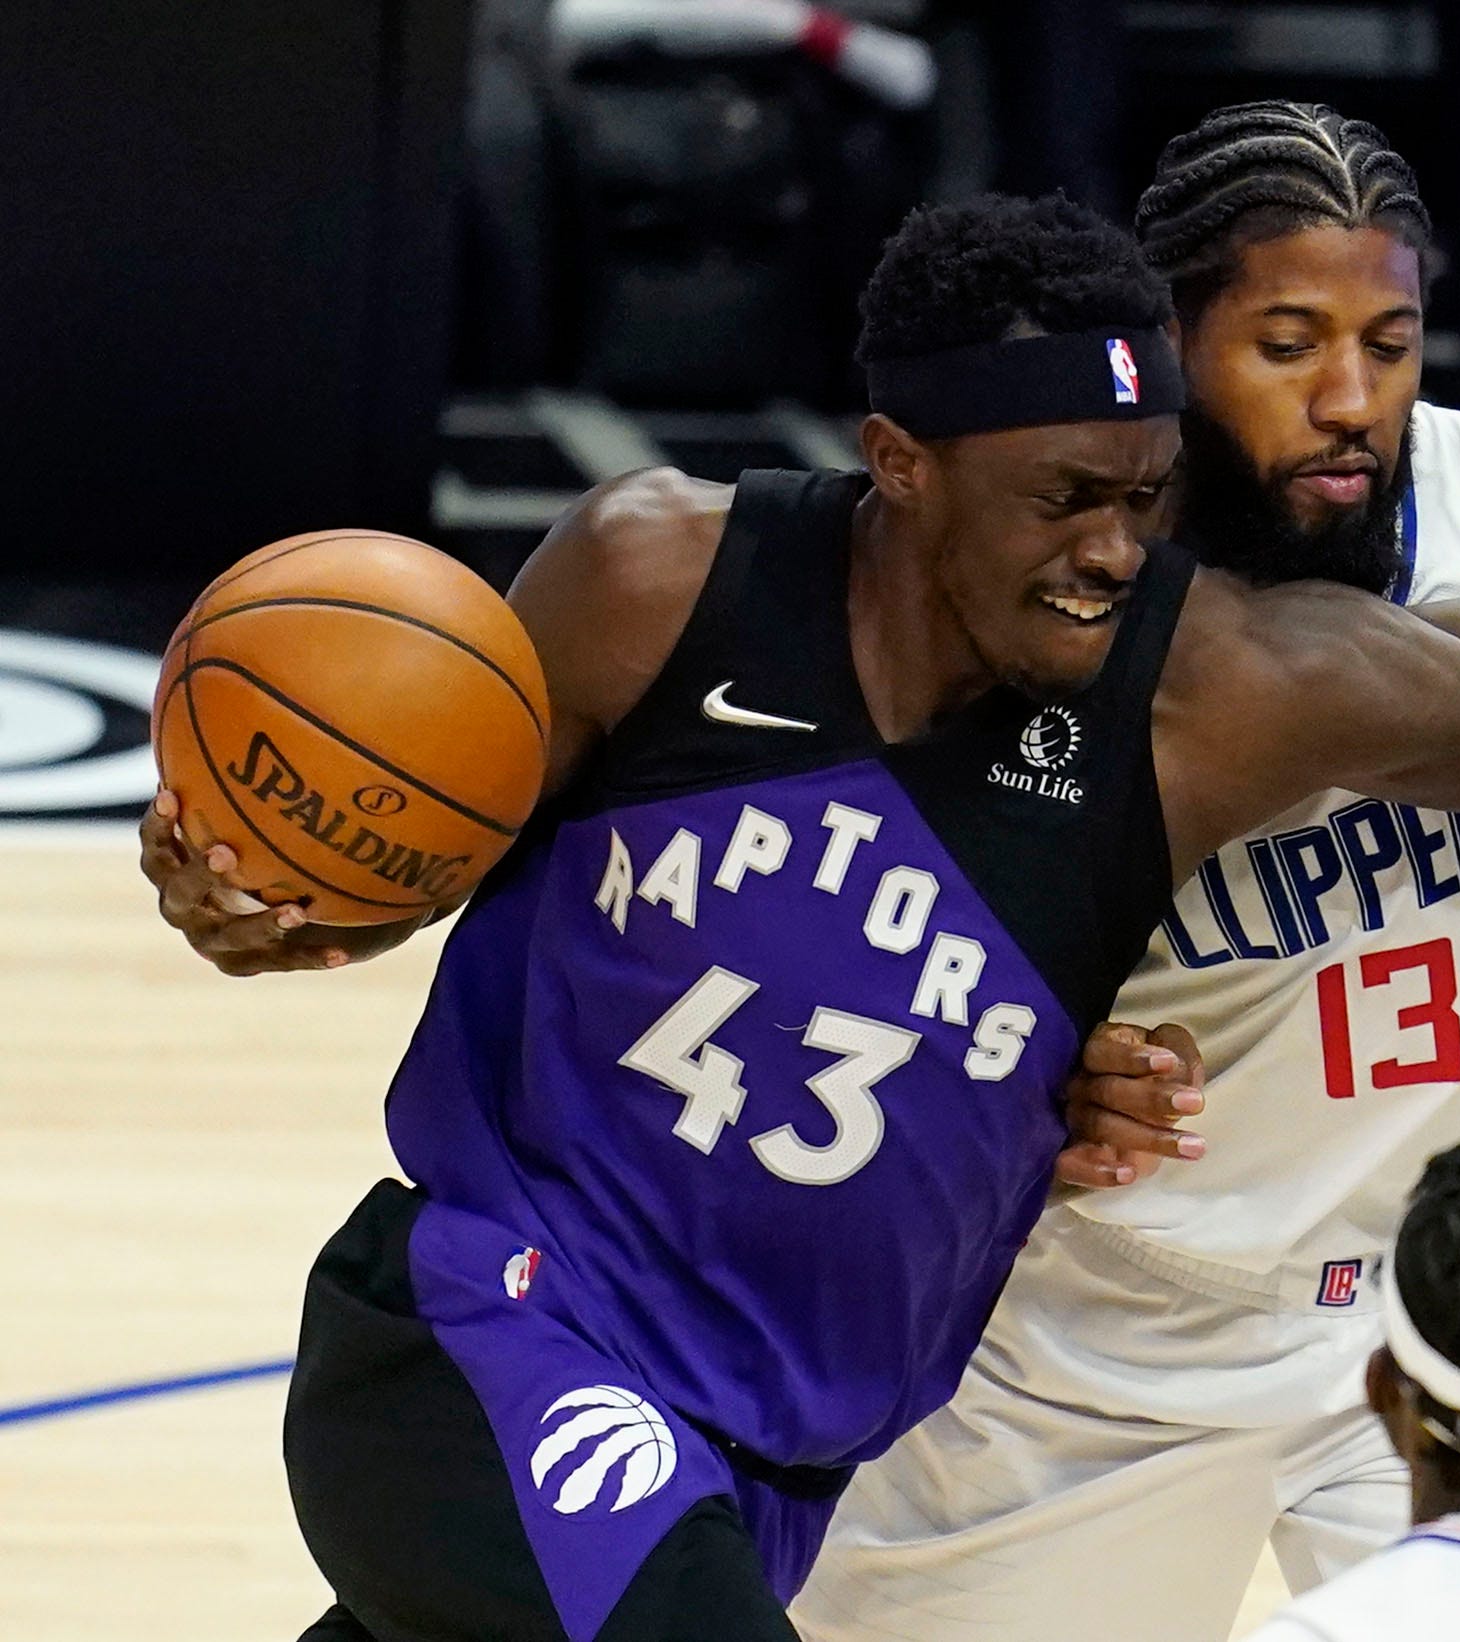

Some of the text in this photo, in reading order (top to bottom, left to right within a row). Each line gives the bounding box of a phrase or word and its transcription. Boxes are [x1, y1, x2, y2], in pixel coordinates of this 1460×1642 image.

[226, 731, 473, 899] SPALDING
[987, 762, 1084, 804] Sun Life
[594, 800, 1037, 1082] RAPTORS
[616, 964, 923, 1186] 43
